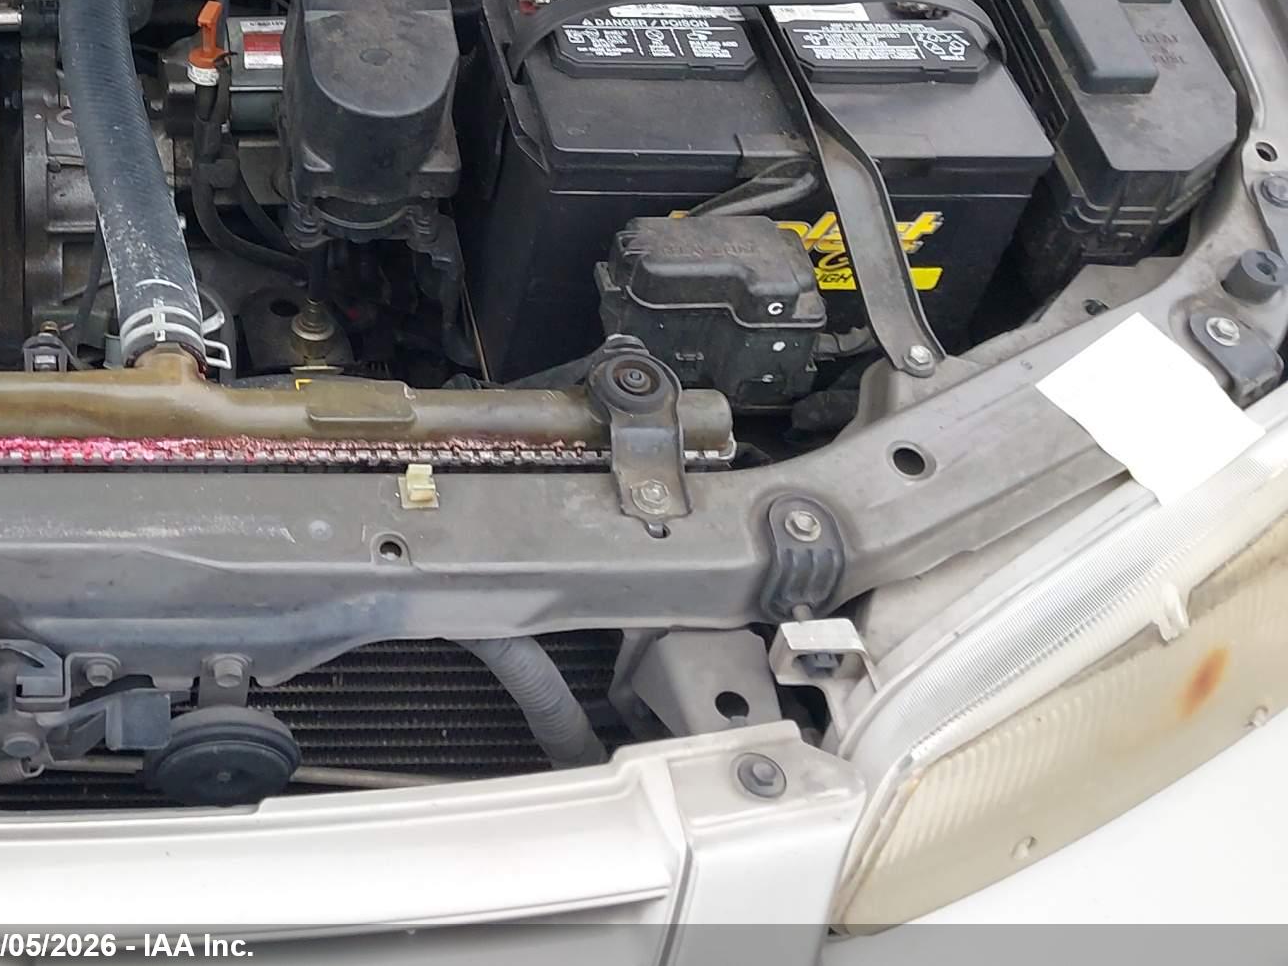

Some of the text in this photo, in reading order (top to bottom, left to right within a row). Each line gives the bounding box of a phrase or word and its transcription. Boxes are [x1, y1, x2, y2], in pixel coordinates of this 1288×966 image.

[593, 18, 648, 27] DANGER
[660, 19, 710, 28] POISON
[815, 273, 853, 283] IGH
[767, 302, 784, 315] C
